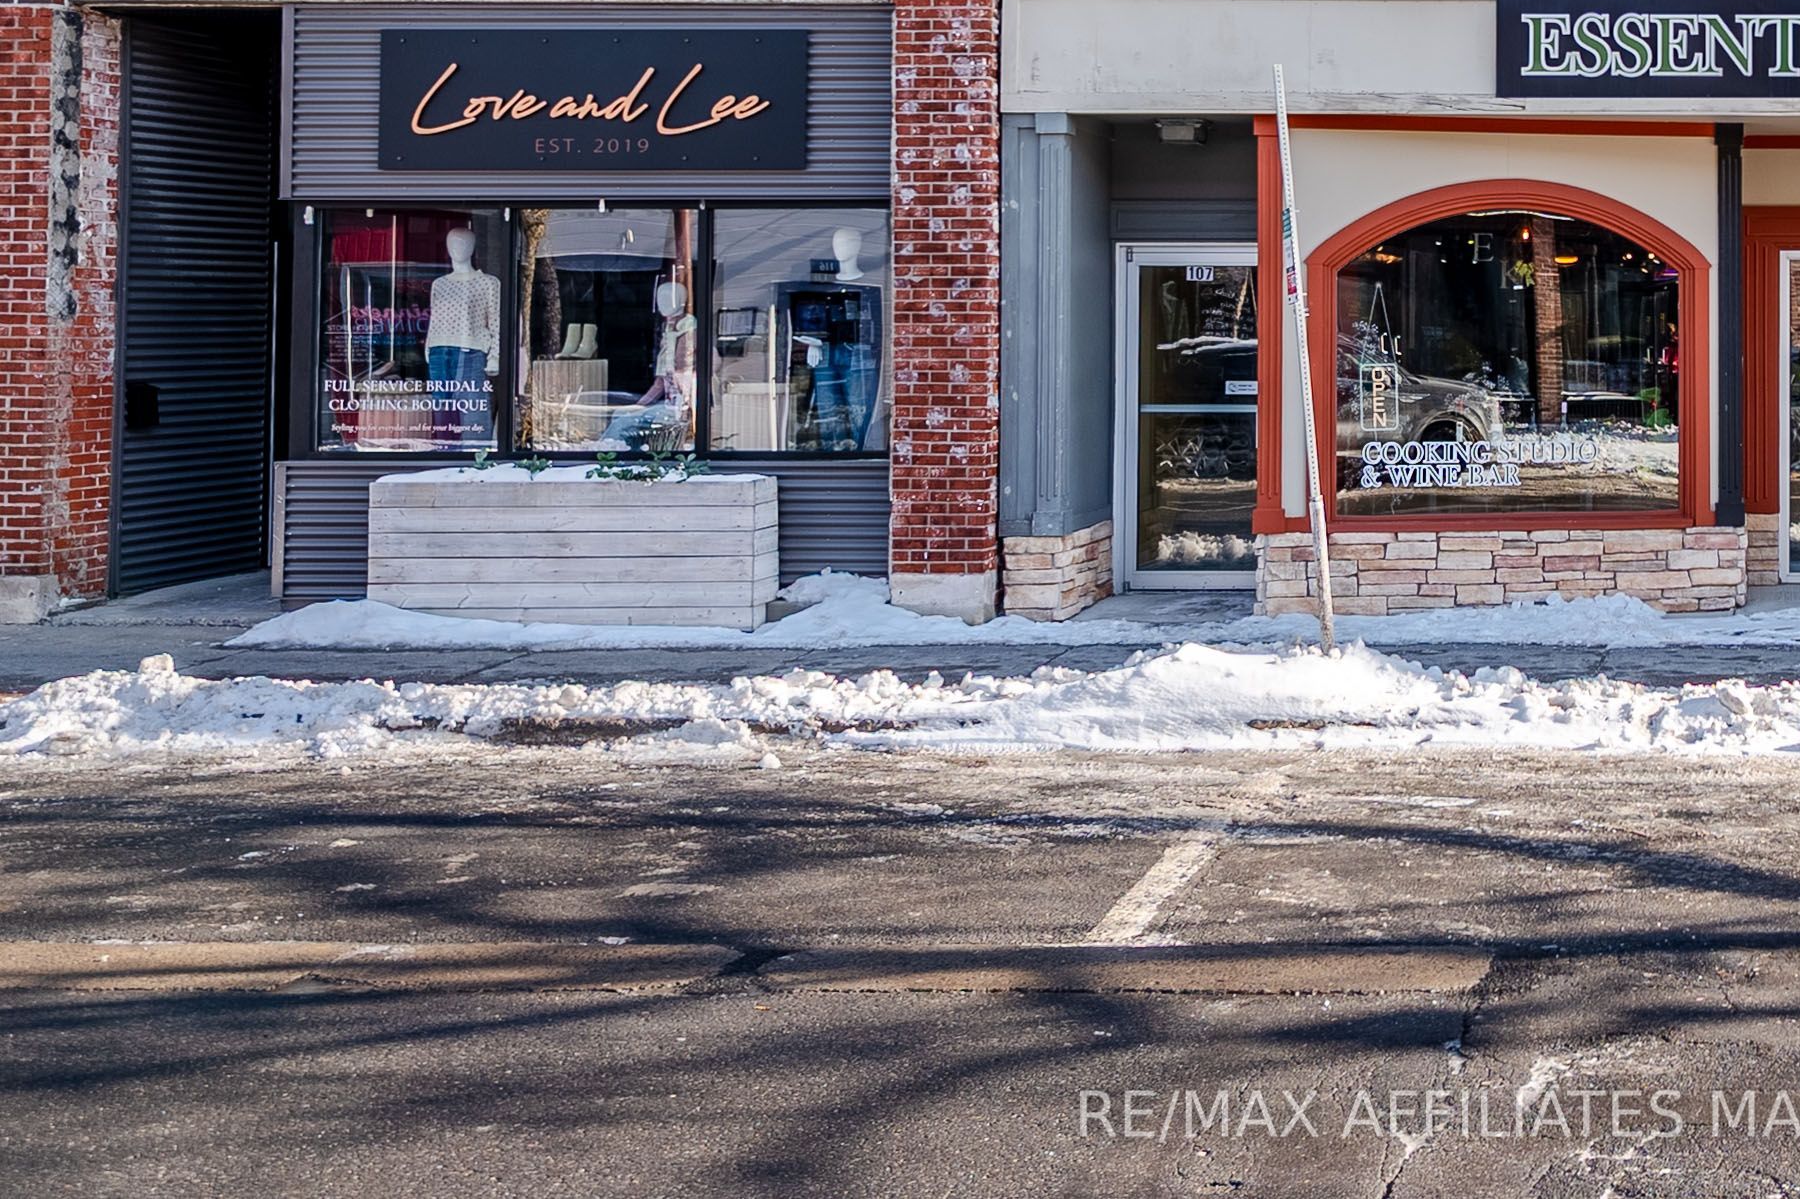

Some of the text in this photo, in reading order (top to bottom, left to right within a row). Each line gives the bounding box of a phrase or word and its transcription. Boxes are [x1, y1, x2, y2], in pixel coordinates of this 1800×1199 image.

[411, 62, 770, 136] Love and Lee
[535, 138, 650, 154] EST. 2019
[1188, 267, 1213, 280] 107
[324, 380, 494, 392] FULL SERVICE BRIDAL &
[328, 399, 488, 413] CLOTHING BOUTIQUE
[1371, 367, 1388, 428] OPEN
[1362, 441, 1598, 465] COOKING STUDIO
[1361, 464, 1522, 488] & WINE BAR
